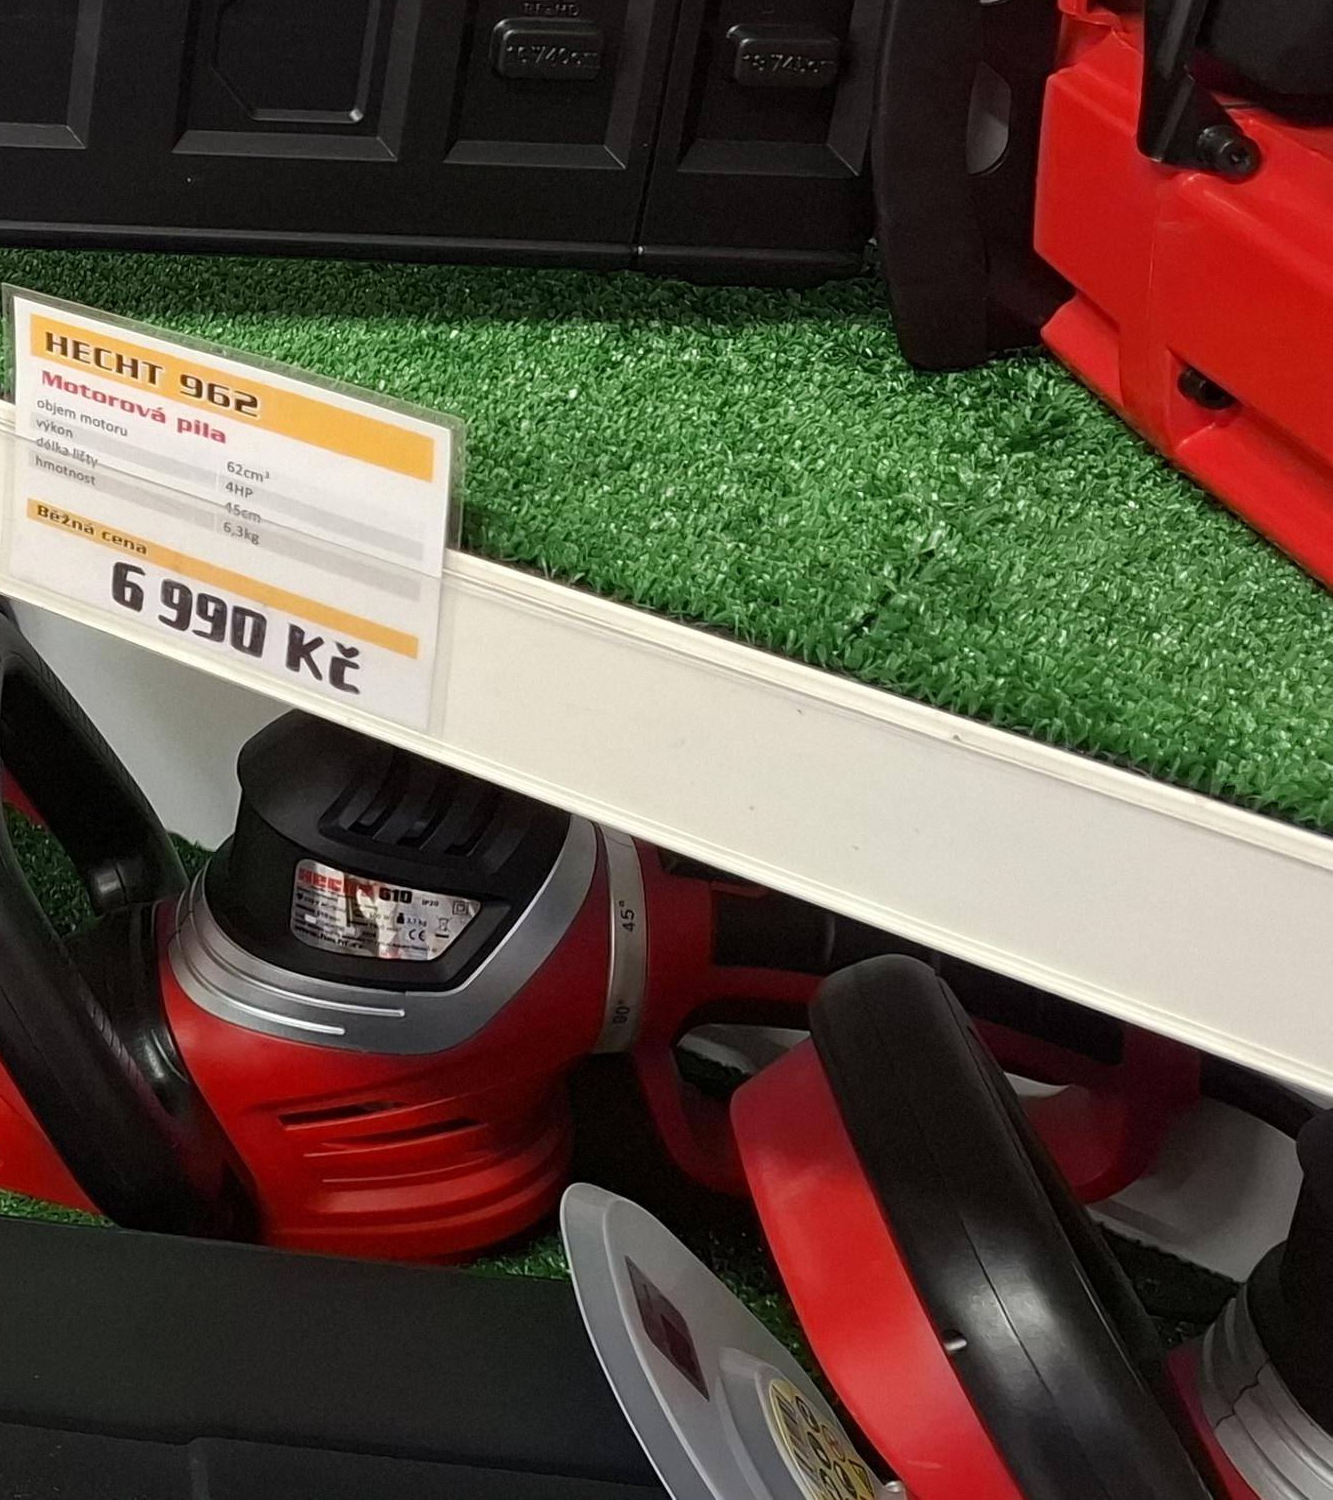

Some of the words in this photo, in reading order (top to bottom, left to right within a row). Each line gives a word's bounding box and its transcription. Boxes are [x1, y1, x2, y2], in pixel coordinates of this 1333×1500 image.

[45, 331, 163, 386] HECHT
[180, 372, 259, 419] 962
[36, 398, 76, 423] objem
[80, 412, 128, 437] motoru
[41, 370, 166, 424] Motorová
[177, 416, 227, 445] pila
[35, 417, 74, 439] výkon
[35, 436, 69, 457] délka
[72, 446, 99, 469] lišty
[35, 456, 96, 486] hmotnost
[225, 481, 254, 499] 4HP
[37, 504, 95, 537] Běžná
[101, 530, 148, 556] cena
[224, 502, 262, 525] 45cm
[223, 521, 260, 546] 6,3kg
[111, 561, 146, 613] 6
[157, 578, 267, 660] 990
[285, 620, 361, 695] Kč
[379, 887, 413, 904] 610
[618, 900, 635, 933] 45°
